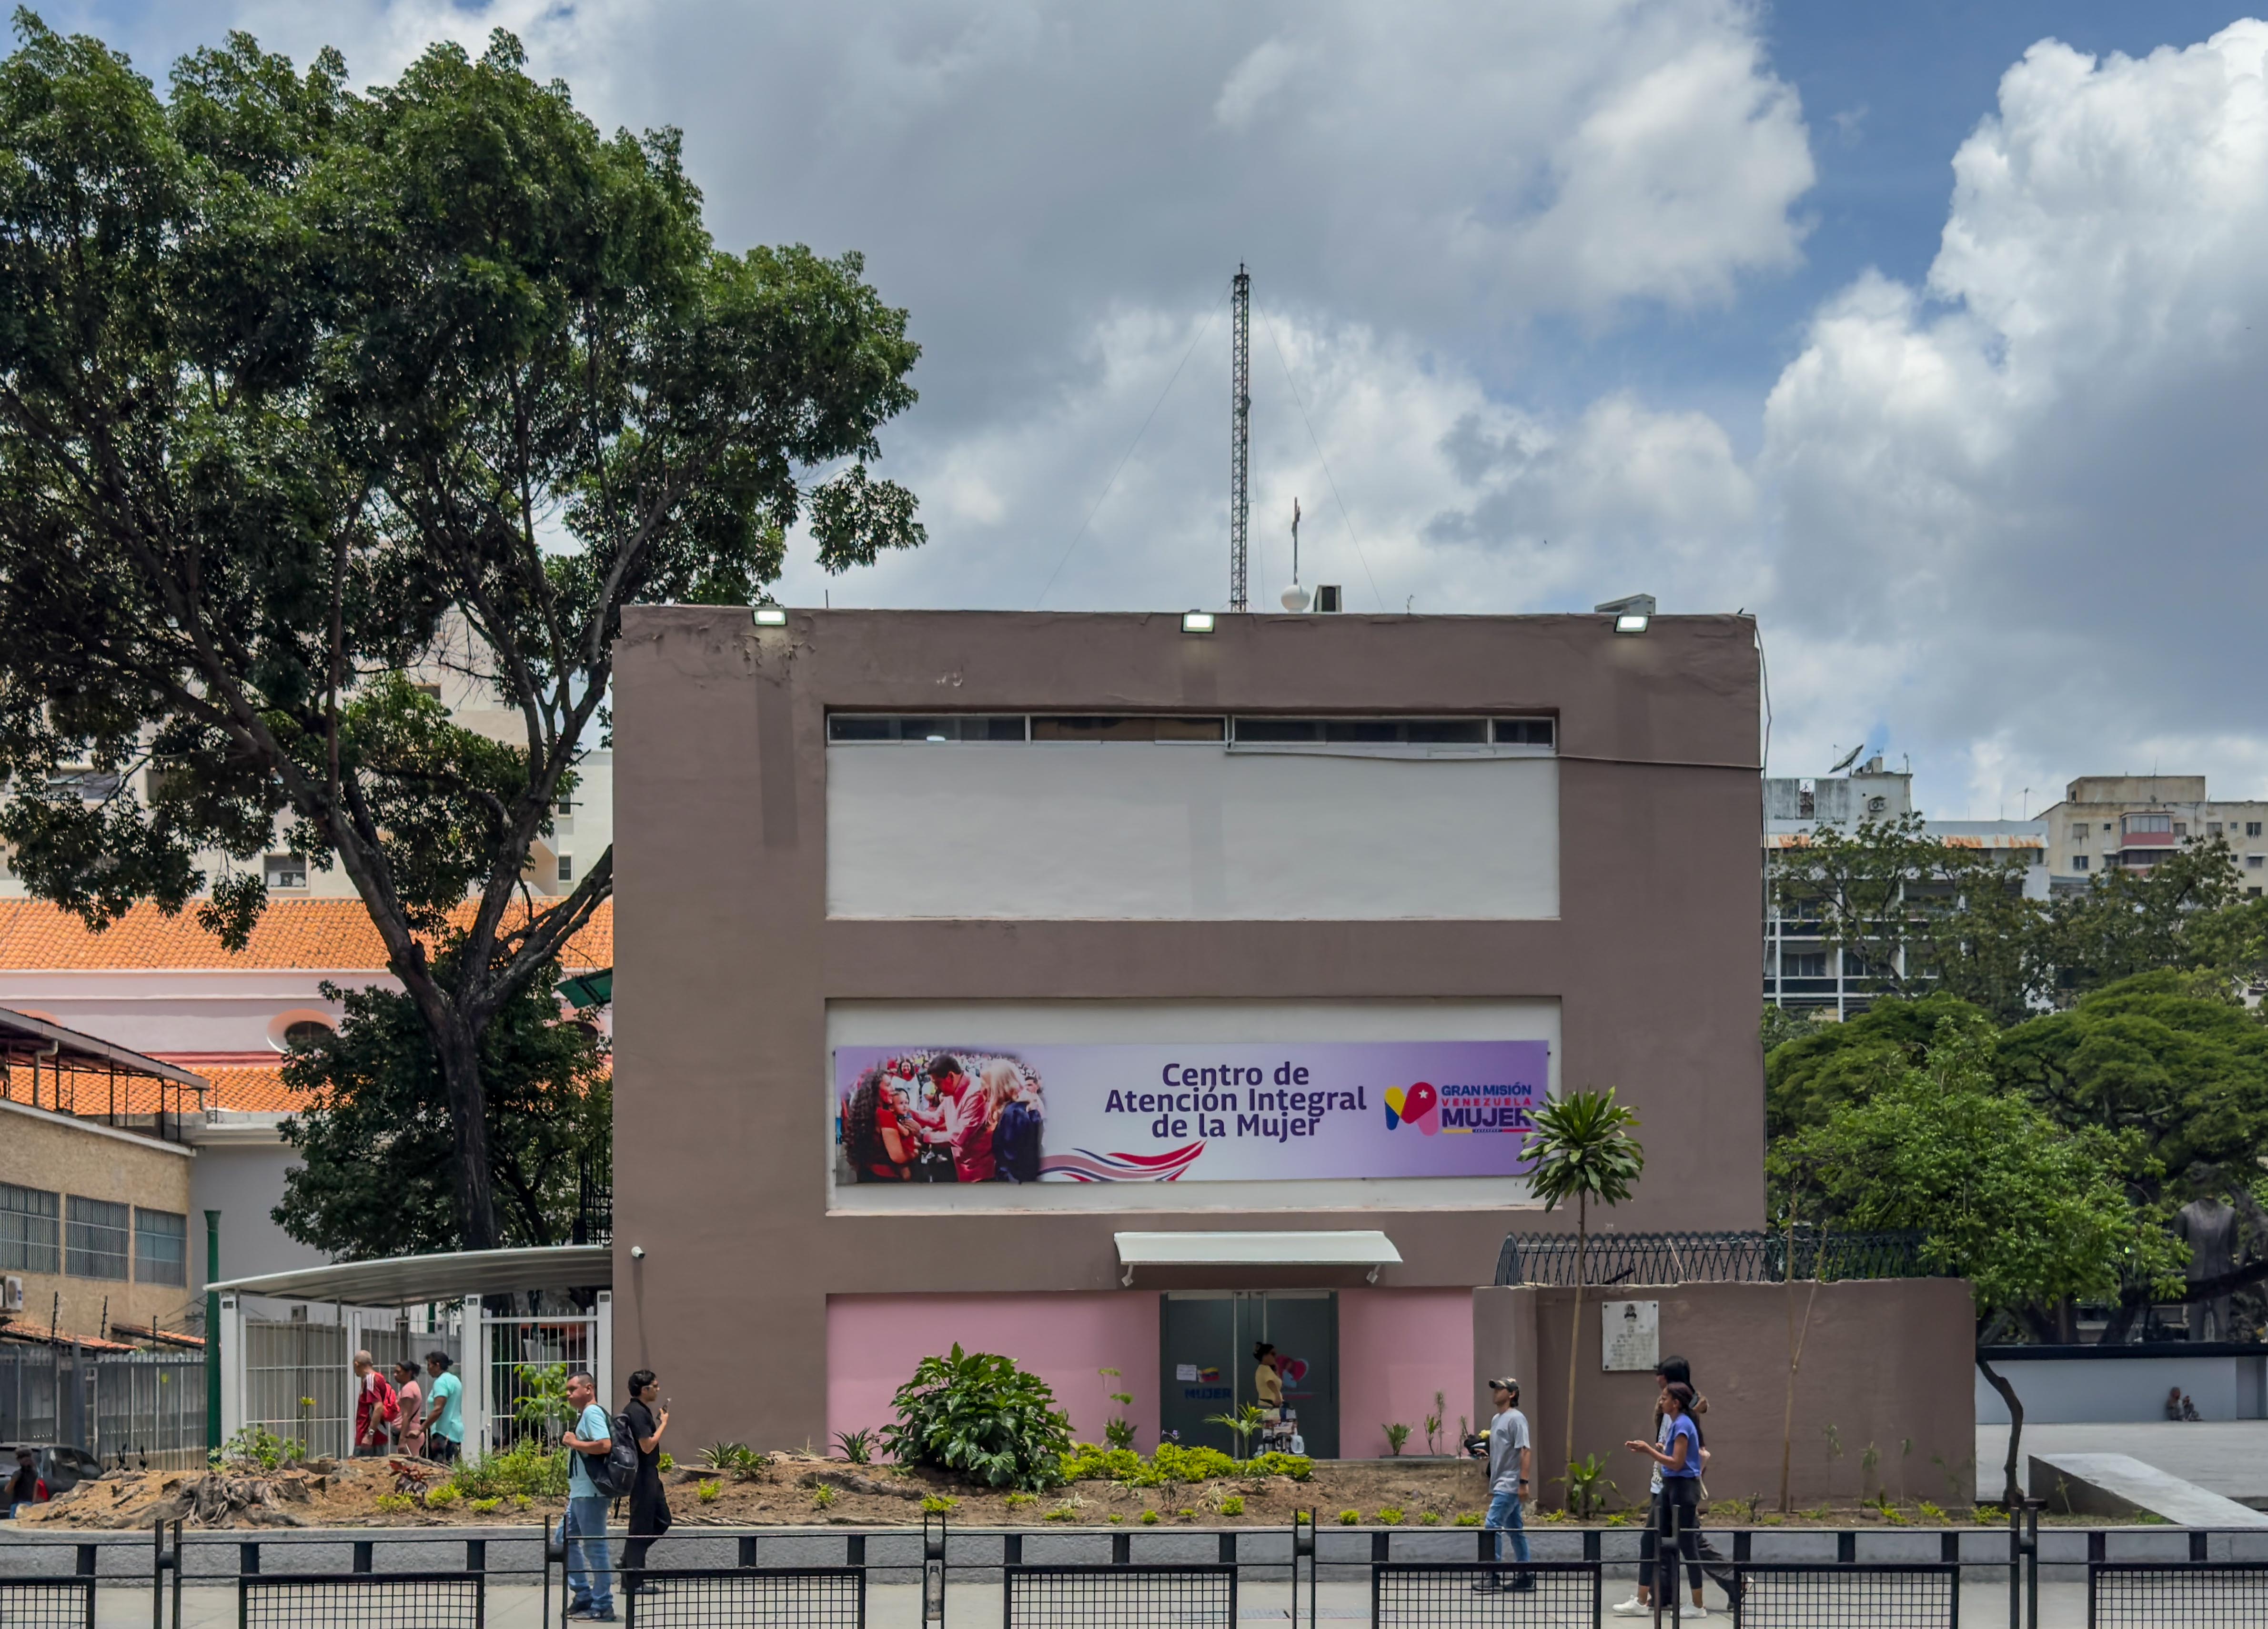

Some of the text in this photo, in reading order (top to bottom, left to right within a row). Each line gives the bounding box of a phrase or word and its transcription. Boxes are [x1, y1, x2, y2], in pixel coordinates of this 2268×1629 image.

[1162, 1061, 1309, 1086] Centro de
[1441, 1082, 1532, 1096] GRAN MISIÓN
[1105, 1086, 1367, 1116] Atención Integral
[1441, 1097, 1532, 1106] VENEZUELA
[1442, 1107, 1532, 1127] MUJER
[1152, 1112, 1320, 1143] de la Mujer
[1185, 1388, 1232, 1399] MUJER
